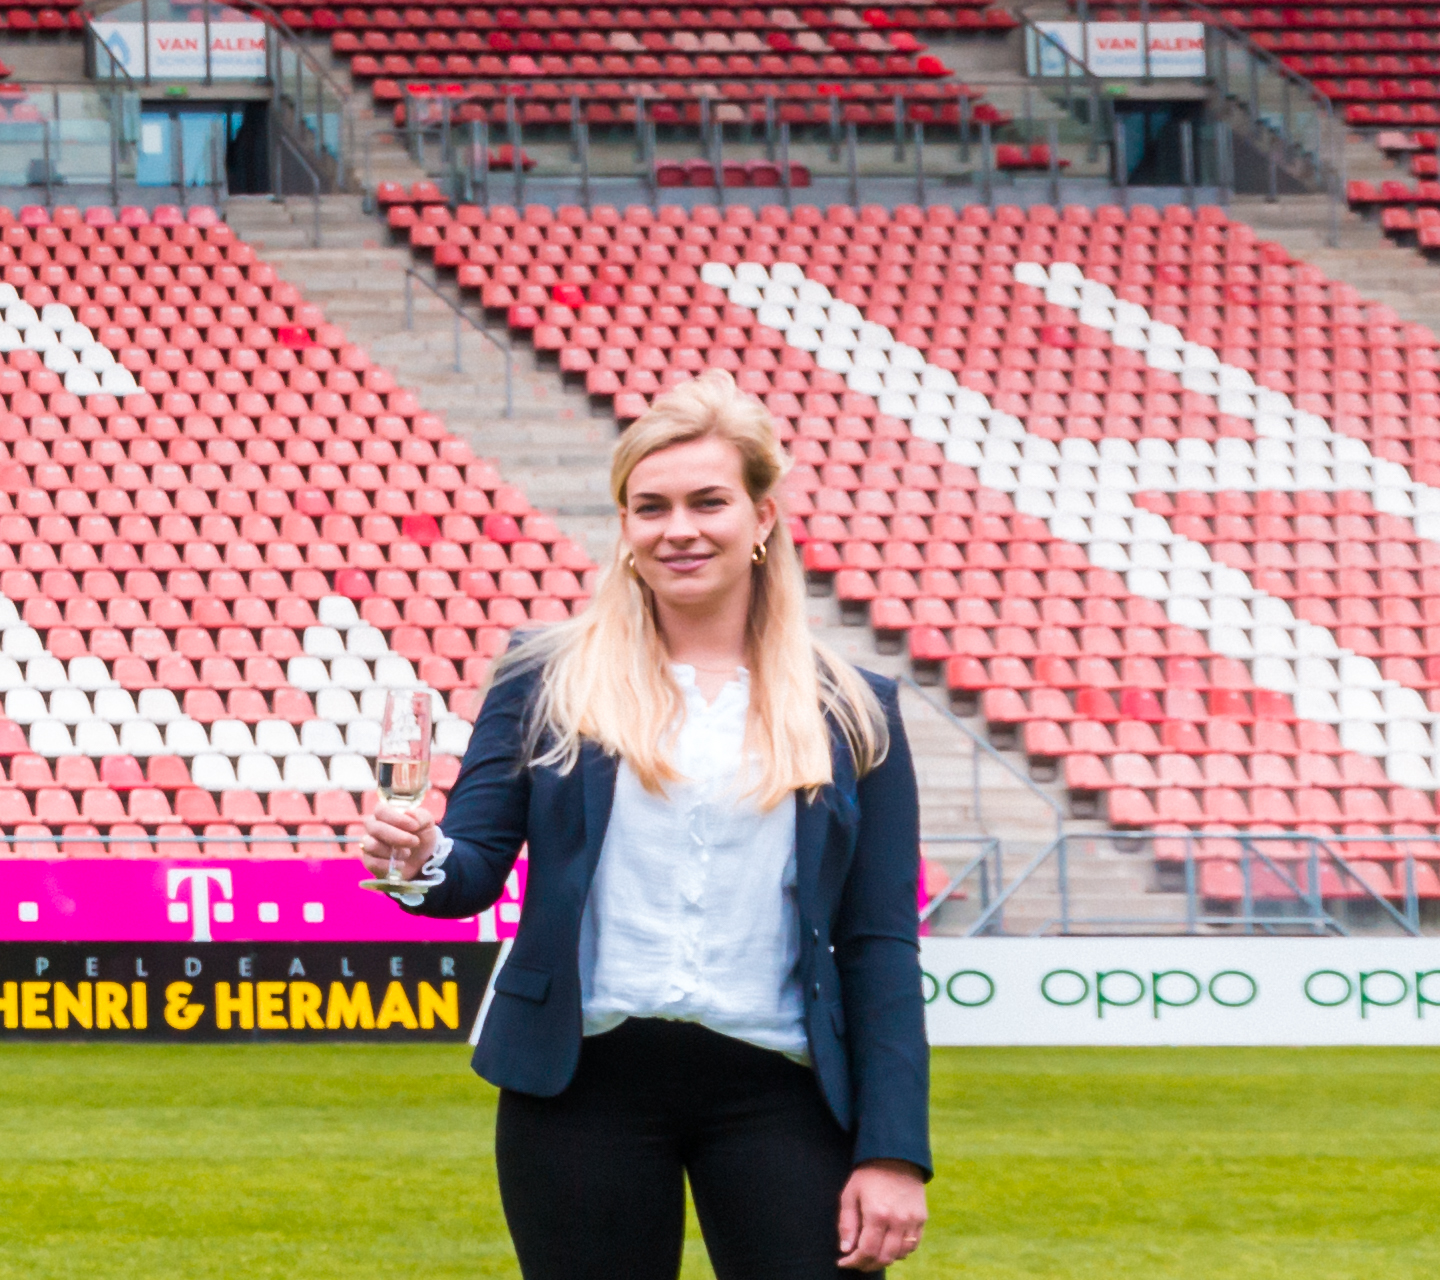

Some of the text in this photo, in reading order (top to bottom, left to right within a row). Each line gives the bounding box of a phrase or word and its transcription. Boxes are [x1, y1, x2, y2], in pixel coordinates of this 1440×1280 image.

[157, 38, 266, 51] VAN ALEM
[1096, 38, 1137, 51] VAN
[167, 868, 233, 942] T
[164, 981, 204, 1030] &
[215, 981, 459, 1030] HERMAN
[1041, 969, 1257, 1019] oppo
